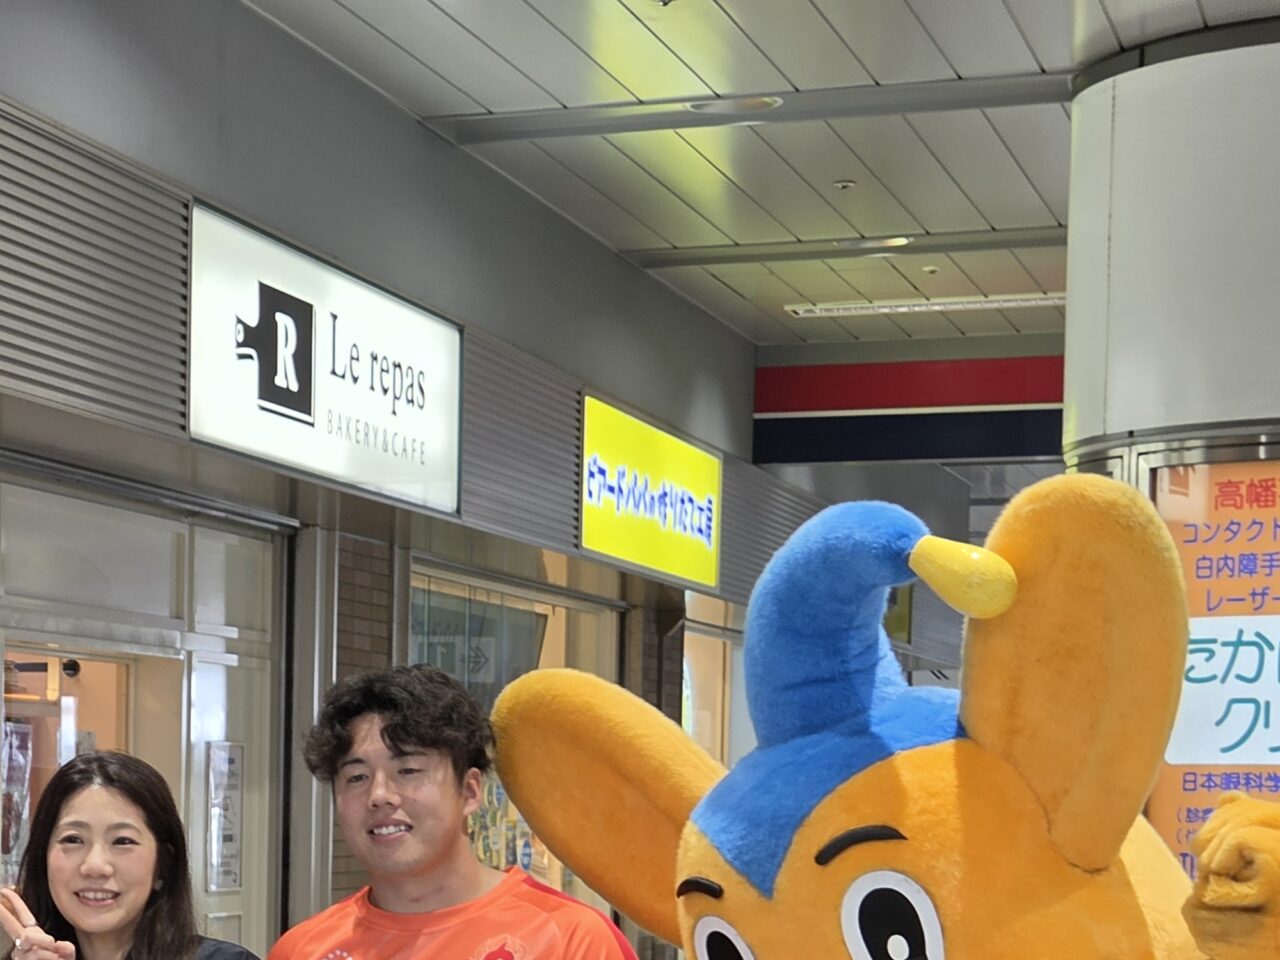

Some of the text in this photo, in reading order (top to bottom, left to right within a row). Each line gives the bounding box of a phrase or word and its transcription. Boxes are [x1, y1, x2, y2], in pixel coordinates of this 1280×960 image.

[330, 311, 426, 417] Le repas
[1213, 477, 1280, 511] 高幡
[1184, 628, 1280, 684] たか
